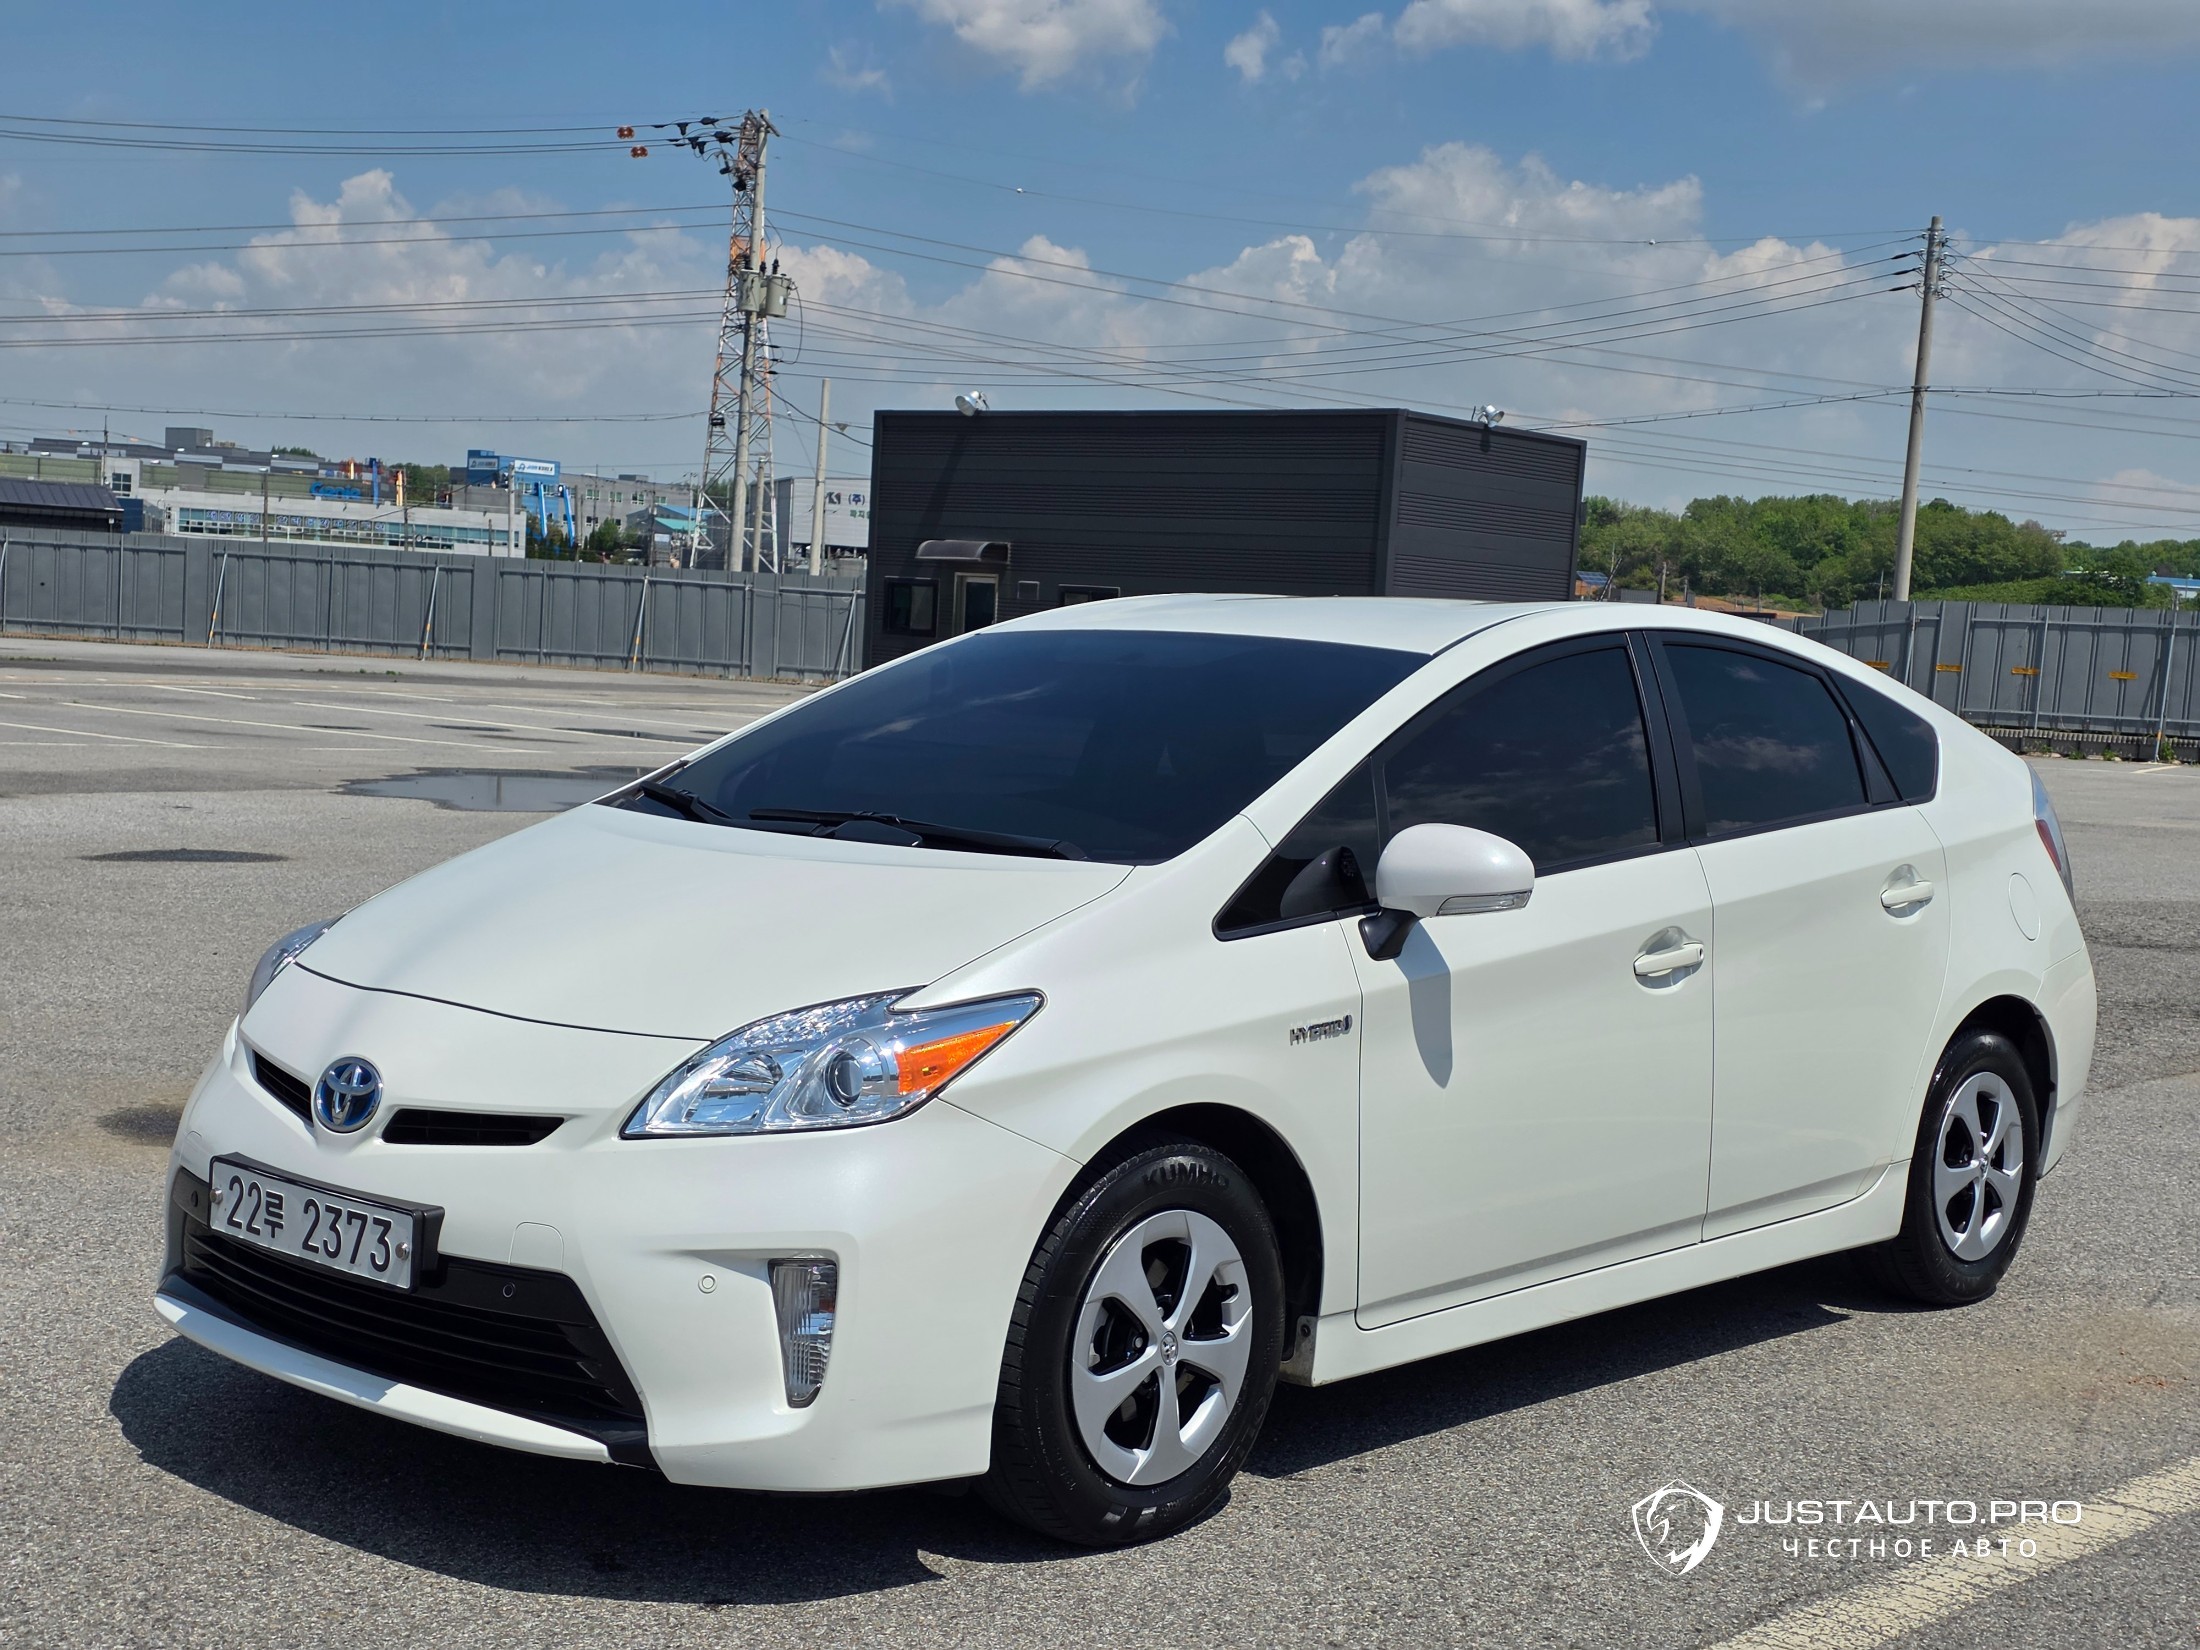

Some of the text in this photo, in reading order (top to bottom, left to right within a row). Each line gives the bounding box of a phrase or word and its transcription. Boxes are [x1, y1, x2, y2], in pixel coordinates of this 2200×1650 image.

[1289, 1019, 1343, 1046] HYBRID
[1141, 1162, 1229, 1188] KUMHO
[227, 1175, 392, 1273] 22루 2373
